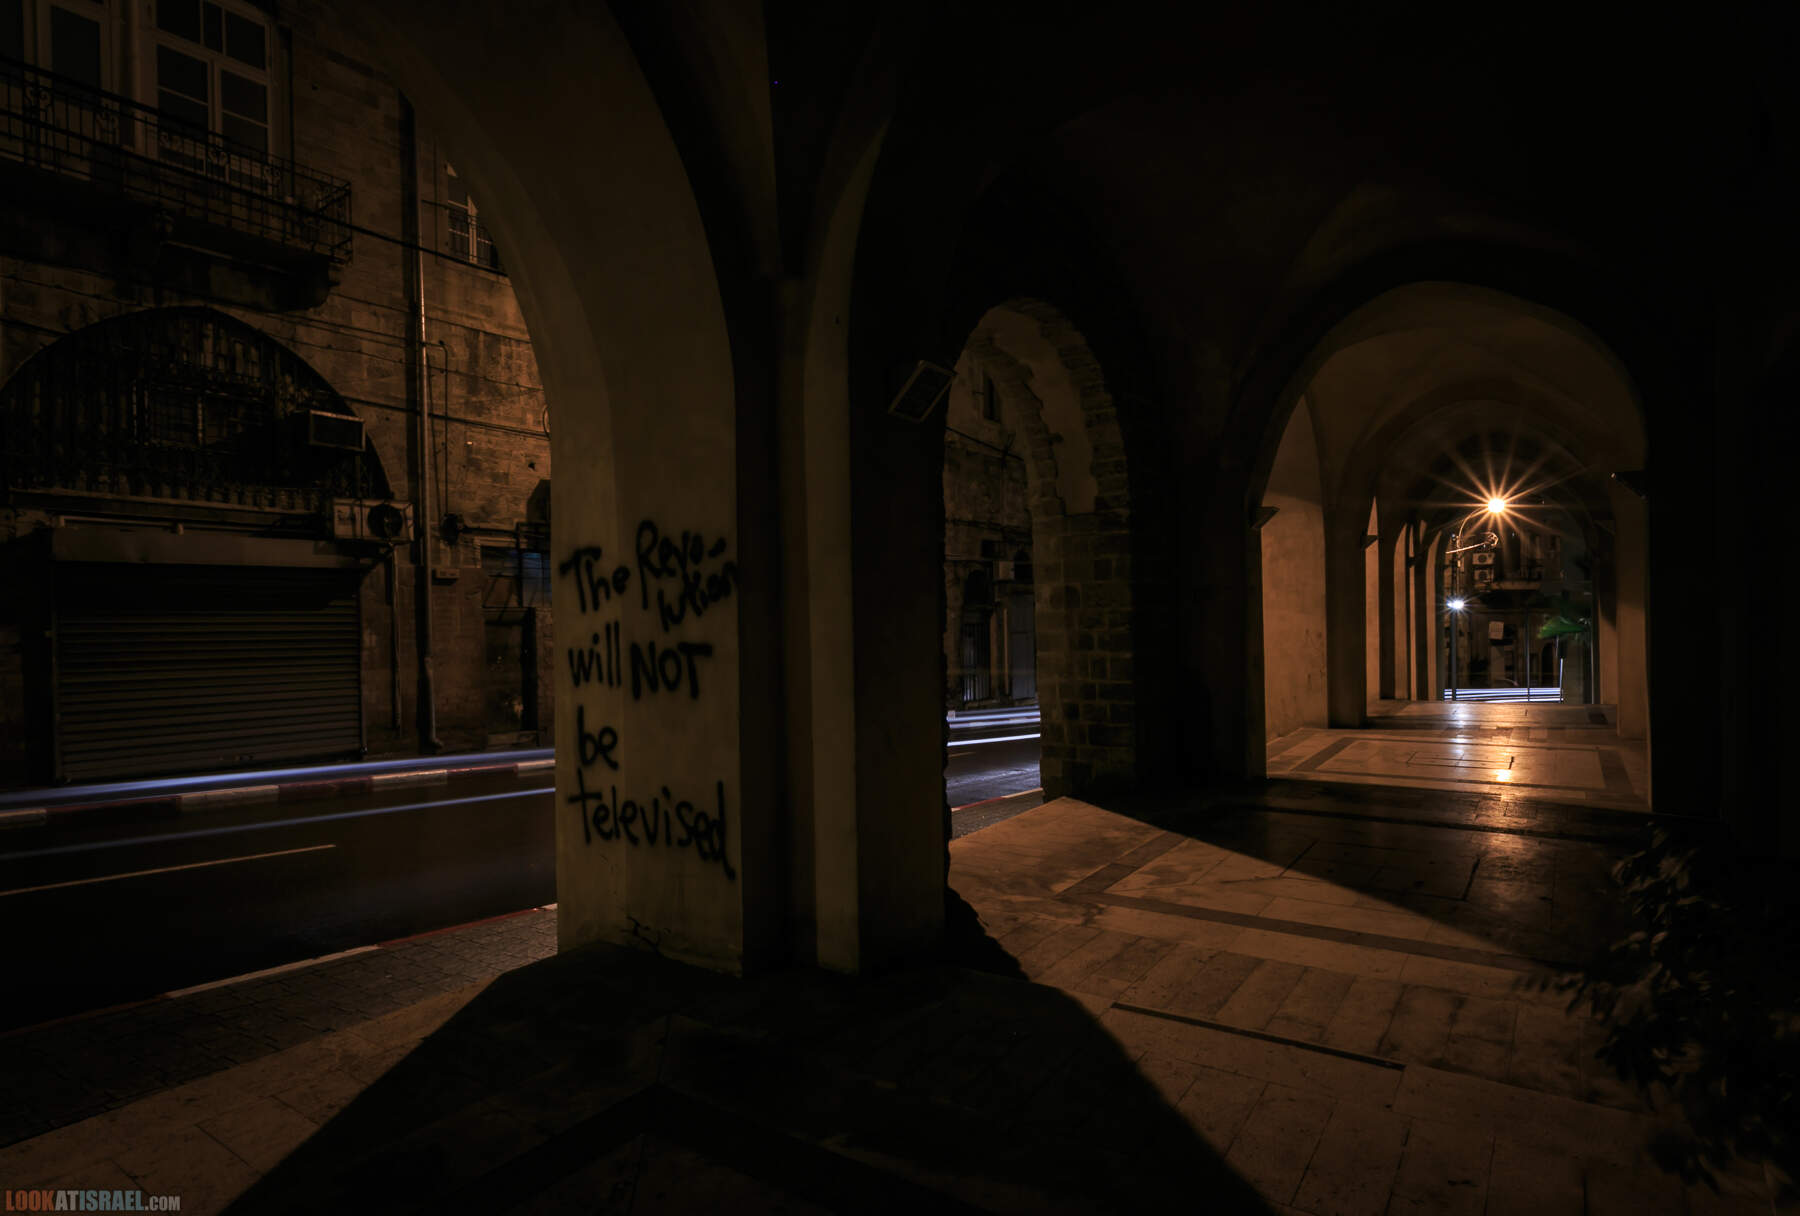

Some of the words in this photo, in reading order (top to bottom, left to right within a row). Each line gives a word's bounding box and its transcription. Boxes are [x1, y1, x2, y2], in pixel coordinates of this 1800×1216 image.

[560, 547, 630, 612] The
[568, 620, 622, 687] will
[630, 641, 713, 699] NOT
[578, 705, 619, 770] be
[567, 766, 736, 880] televised
